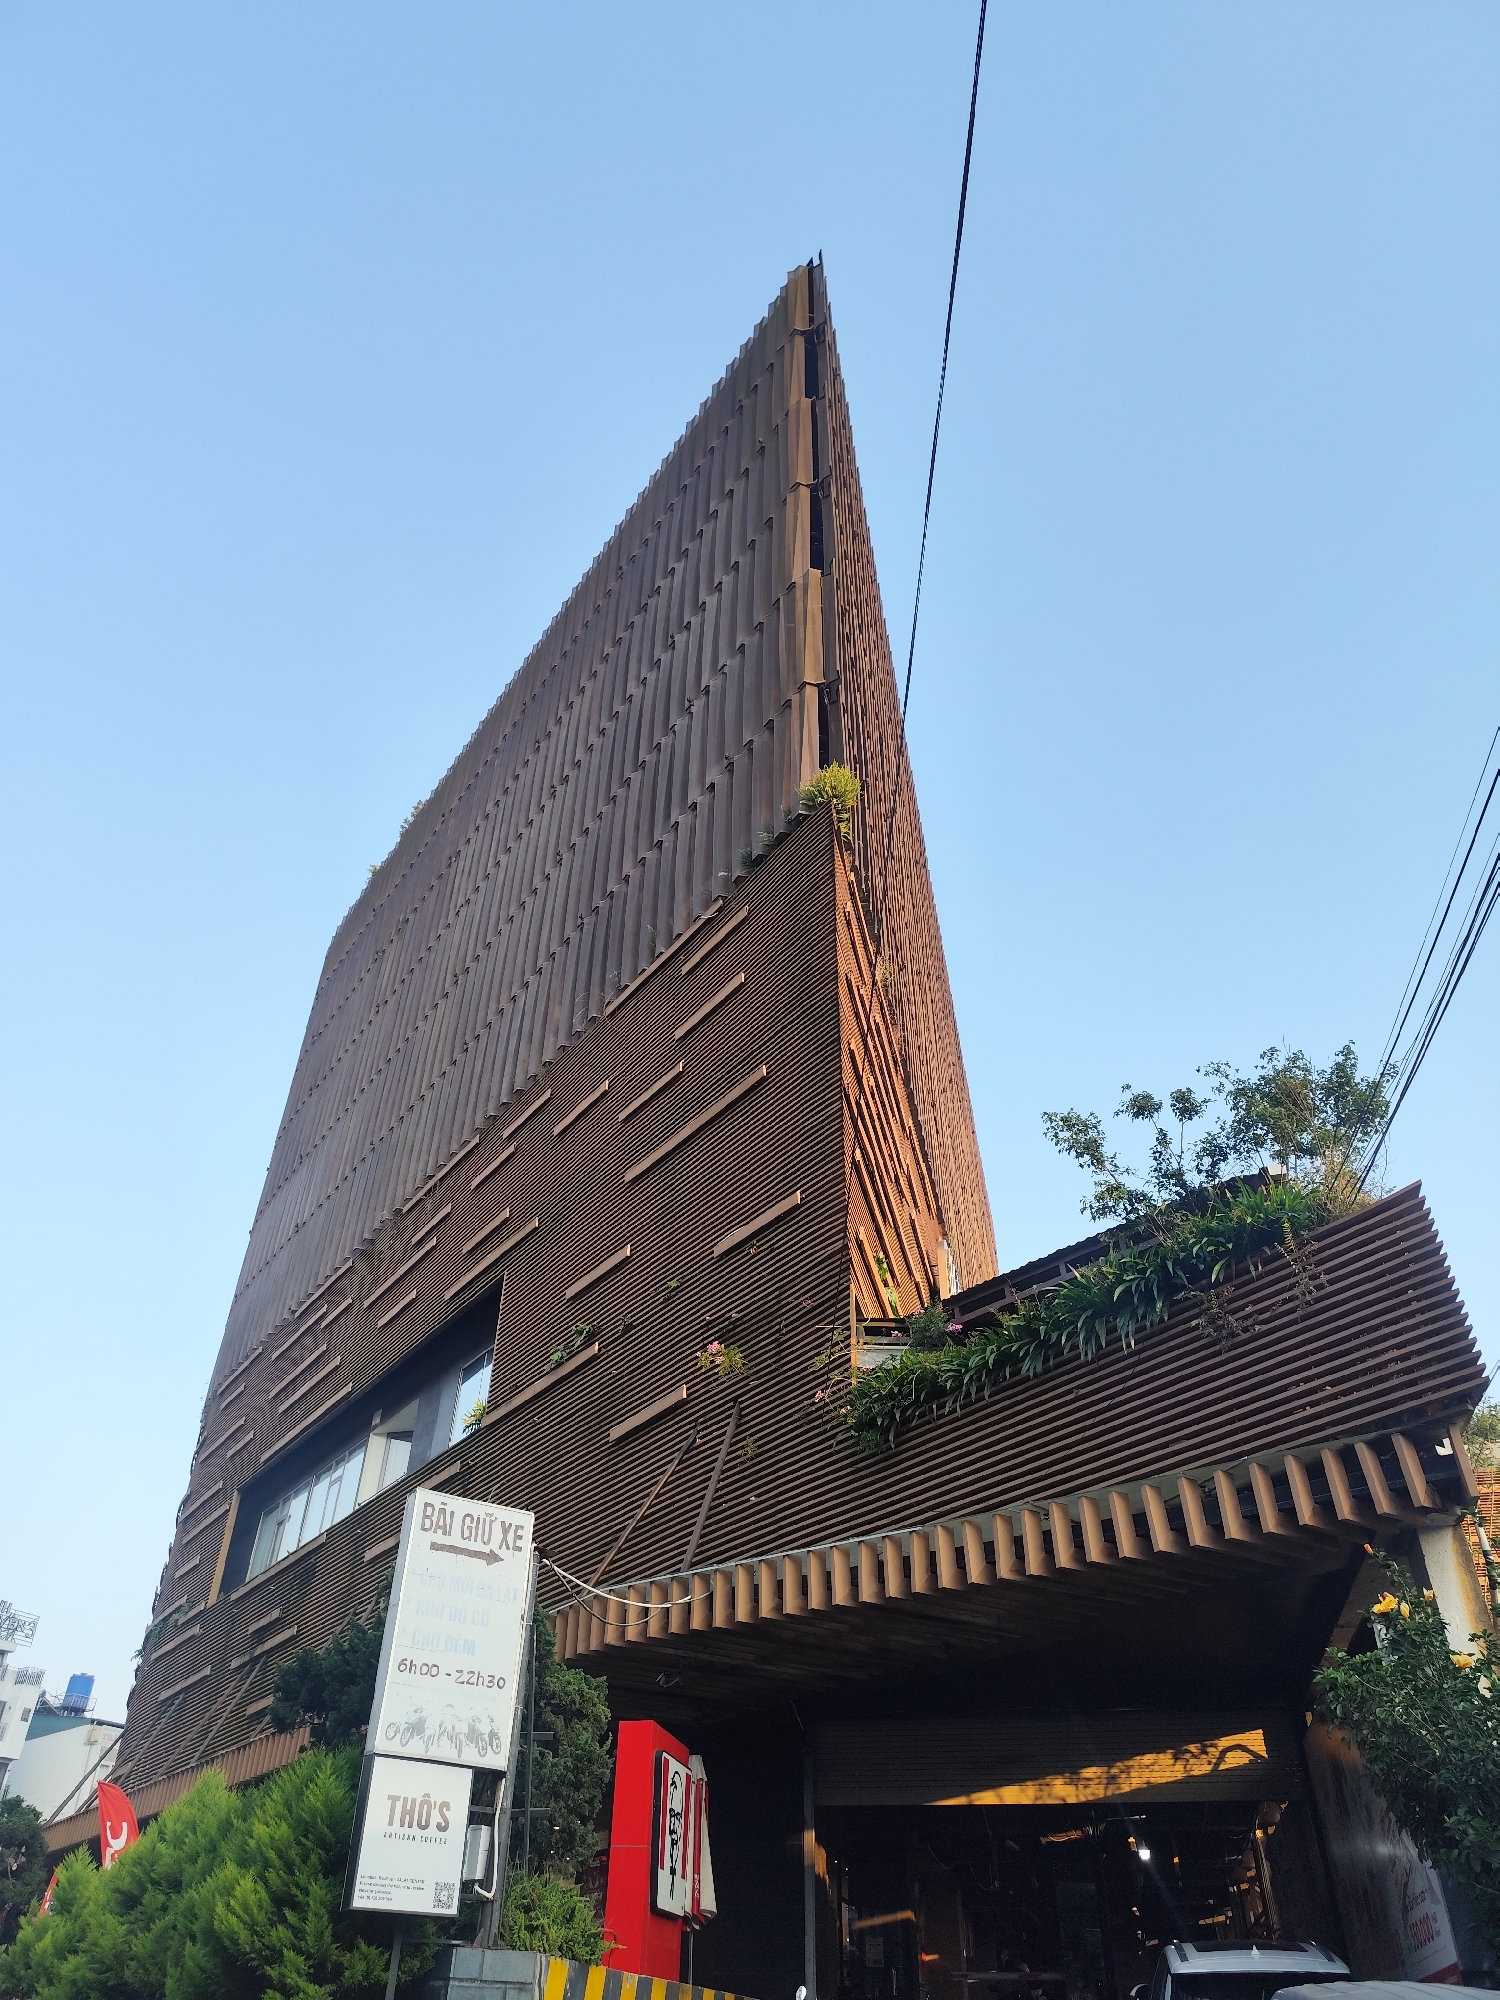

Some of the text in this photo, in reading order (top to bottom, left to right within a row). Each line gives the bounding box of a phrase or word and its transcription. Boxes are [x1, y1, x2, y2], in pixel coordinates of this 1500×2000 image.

[420, 1502, 525, 1552] BÃI GIỮ XE
[416, 1598, 445, 1620] KHU
[411, 1628, 476, 1656] CHỢ ĐÊM
[397, 1658, 440, 1677] 6h00
[387, 1793, 451, 1832] THÔ'S
[383, 1831, 448, 1845] ARTISAN COFFEE
